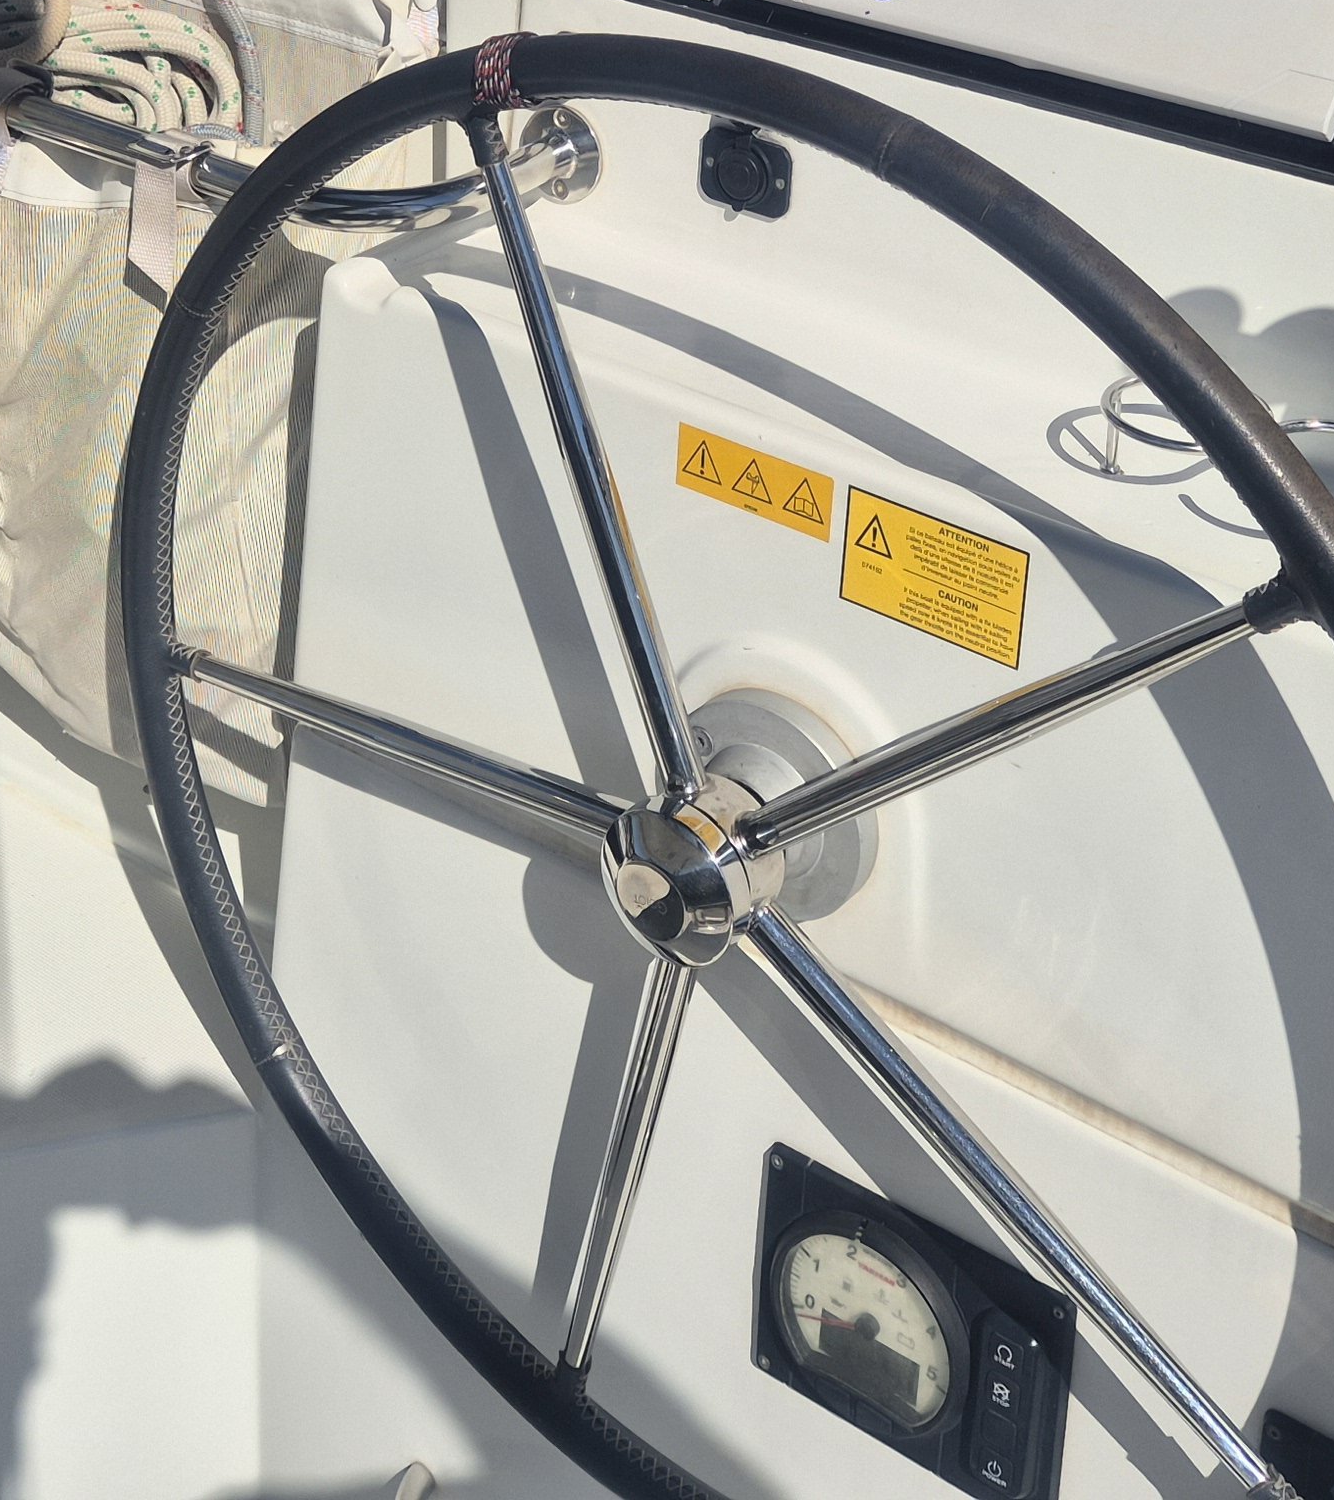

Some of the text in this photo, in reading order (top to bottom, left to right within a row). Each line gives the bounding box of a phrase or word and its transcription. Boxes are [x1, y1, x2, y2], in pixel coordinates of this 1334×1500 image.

[938, 526, 989, 553] ATTENTION
[938, 588, 978, 612] CAUTION
[846, 1244, 857, 1260] 2
[812, 1258, 820, 1273] 1
[805, 1294, 815, 1309] 0
[926, 1325, 937, 1340] 4
[994, 1354, 1015, 1370] START
[926, 1365, 938, 1381] 5
[992, 1395, 1011, 1408] STOP
[982, 1469, 1007, 1488] POWER
